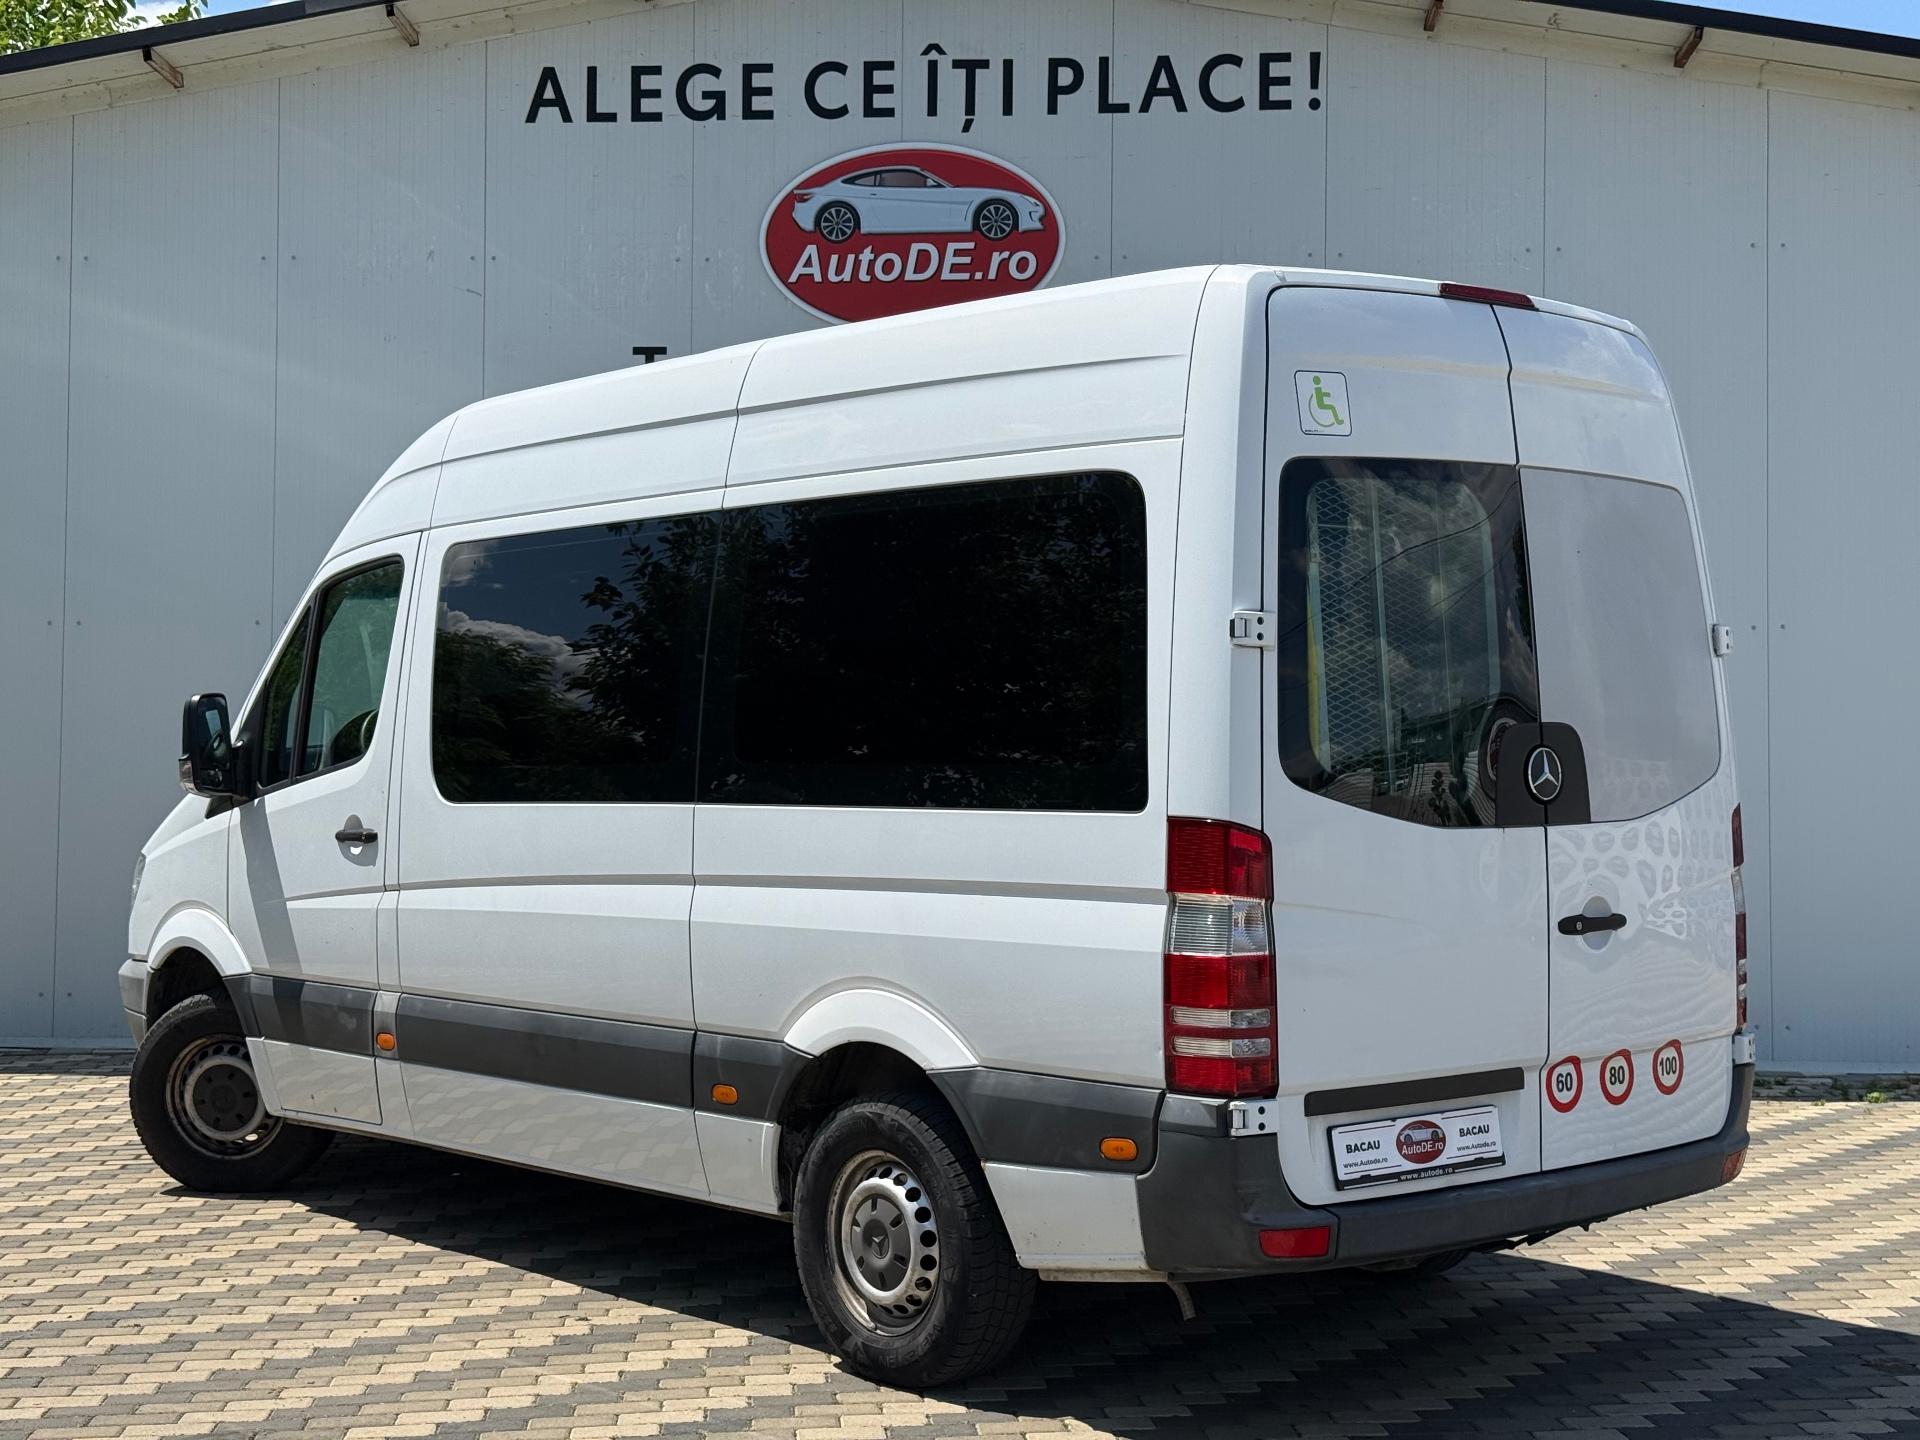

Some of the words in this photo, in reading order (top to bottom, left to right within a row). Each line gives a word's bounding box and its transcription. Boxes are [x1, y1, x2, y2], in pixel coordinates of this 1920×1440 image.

[524, 62, 775, 124] ALEGE
[804, 60, 897, 120] CE
[1046, 51, 1322, 116] PLACE!
[787, 241, 1038, 284] AutoDE.ro
[1659, 1056, 1677, 1076] 100
[1556, 1072, 1573, 1093] 60
[1609, 1065, 1625, 1086] 80
[1458, 1124, 1490, 1138] BACAU
[1345, 1140, 1381, 1154] BACAU
[1401, 1140, 1444, 1156] AutoDE.ro
[1343, 1157, 1388, 1169] www.Autode.ro
[1400, 1167, 1453, 1181] www.autode.ro
